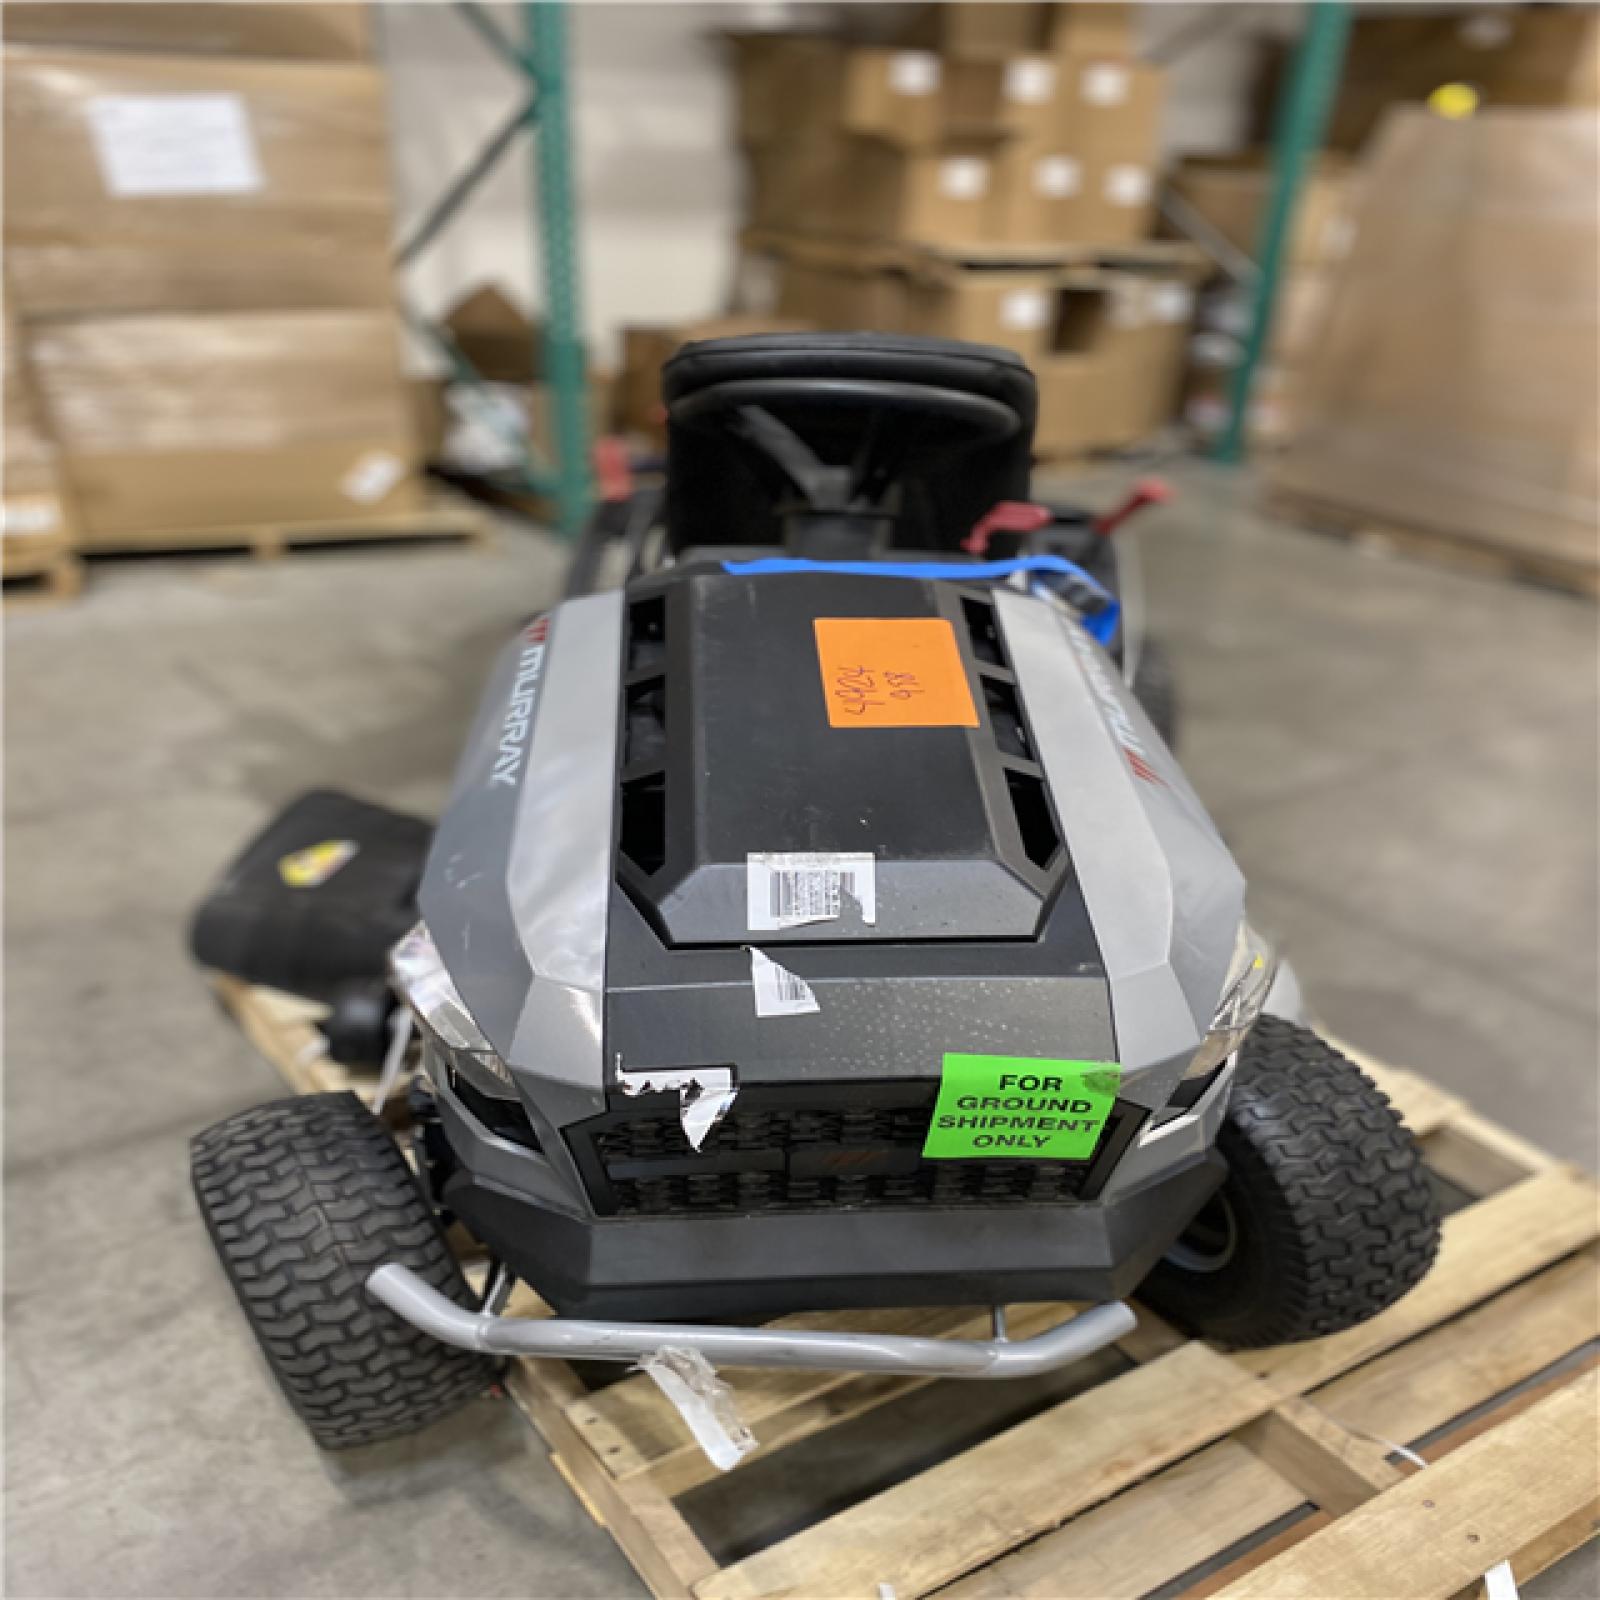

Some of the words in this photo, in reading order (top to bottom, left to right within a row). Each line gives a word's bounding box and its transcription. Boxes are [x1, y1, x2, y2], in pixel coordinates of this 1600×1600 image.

[999, 1074, 1064, 1092] FOR
[956, 1094, 1093, 1114] GROUND
[936, 1114, 1102, 1133] SHIPMENT
[971, 1134, 1052, 1149] ONLY
